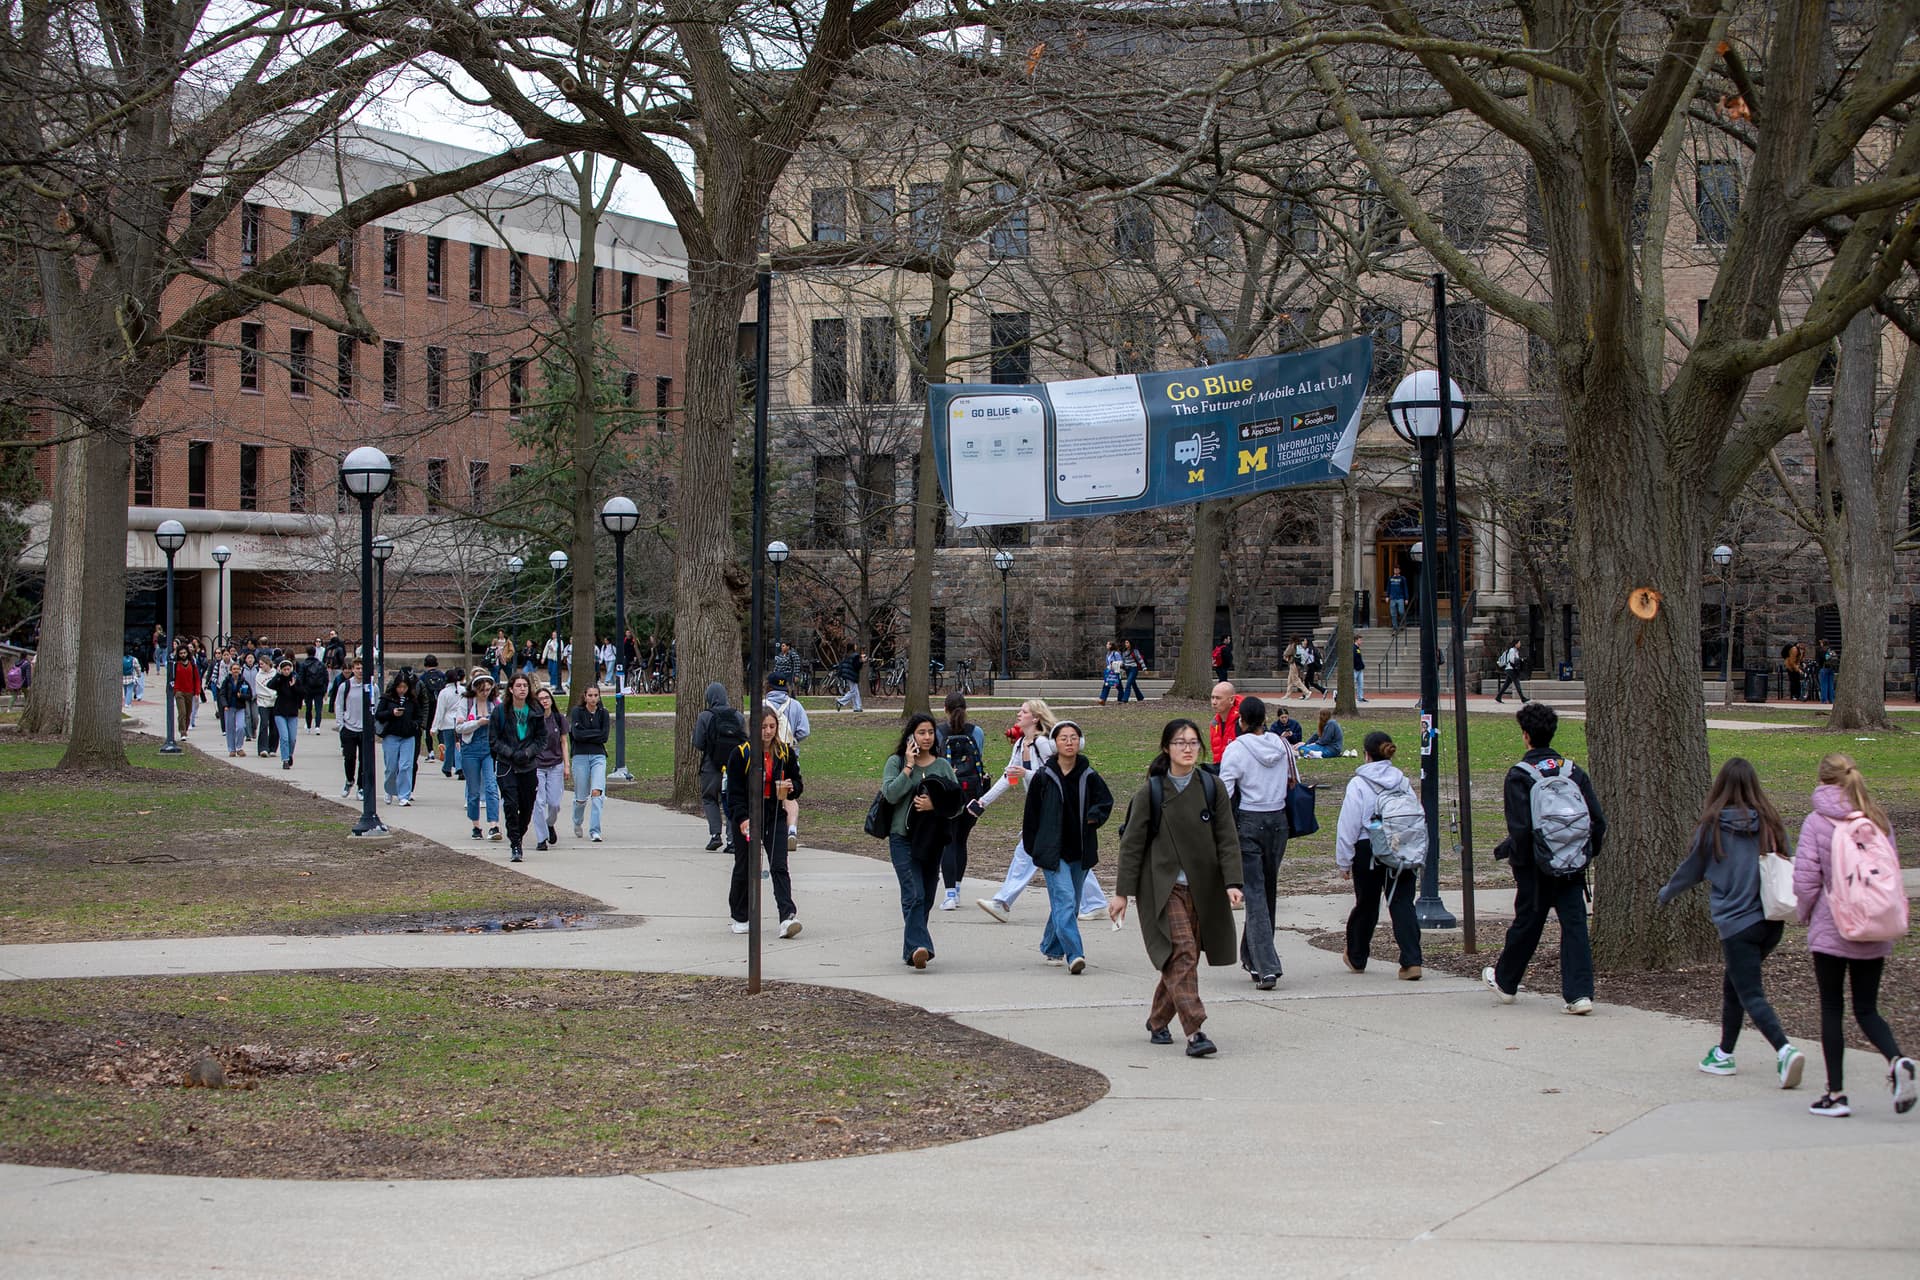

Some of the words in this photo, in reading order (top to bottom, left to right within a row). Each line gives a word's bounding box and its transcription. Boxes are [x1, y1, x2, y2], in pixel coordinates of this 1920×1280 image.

[1166, 382, 1200, 401] Go
[1202, 374, 1254, 396] Blue
[1171, 403, 1199, 416] The
[1201, 400, 1241, 413] Future
[1242, 393, 1256, 406] of
[1257, 385, 1295, 403] Mobile
[1297, 381, 1313, 395] AI
[1313, 381, 1326, 392] at
[1327, 373, 1353, 389] U-M
[971, 409, 985, 418] GO
[987, 407, 1011, 417] BLUE
[1304, 415, 1324, 426] Google
[1323, 414, 1336, 422] Play
[1251, 428, 1264, 437] App
[1264, 425, 1281, 434] Store
[1277, 433, 1330, 452] INFORMATION
[1237, 446, 1268, 475] M
[1278, 443, 1325, 461] TECHNOLOGY
[1277, 455, 1311, 468] UNIVERSITY
[1187, 468, 1205, 484] M
